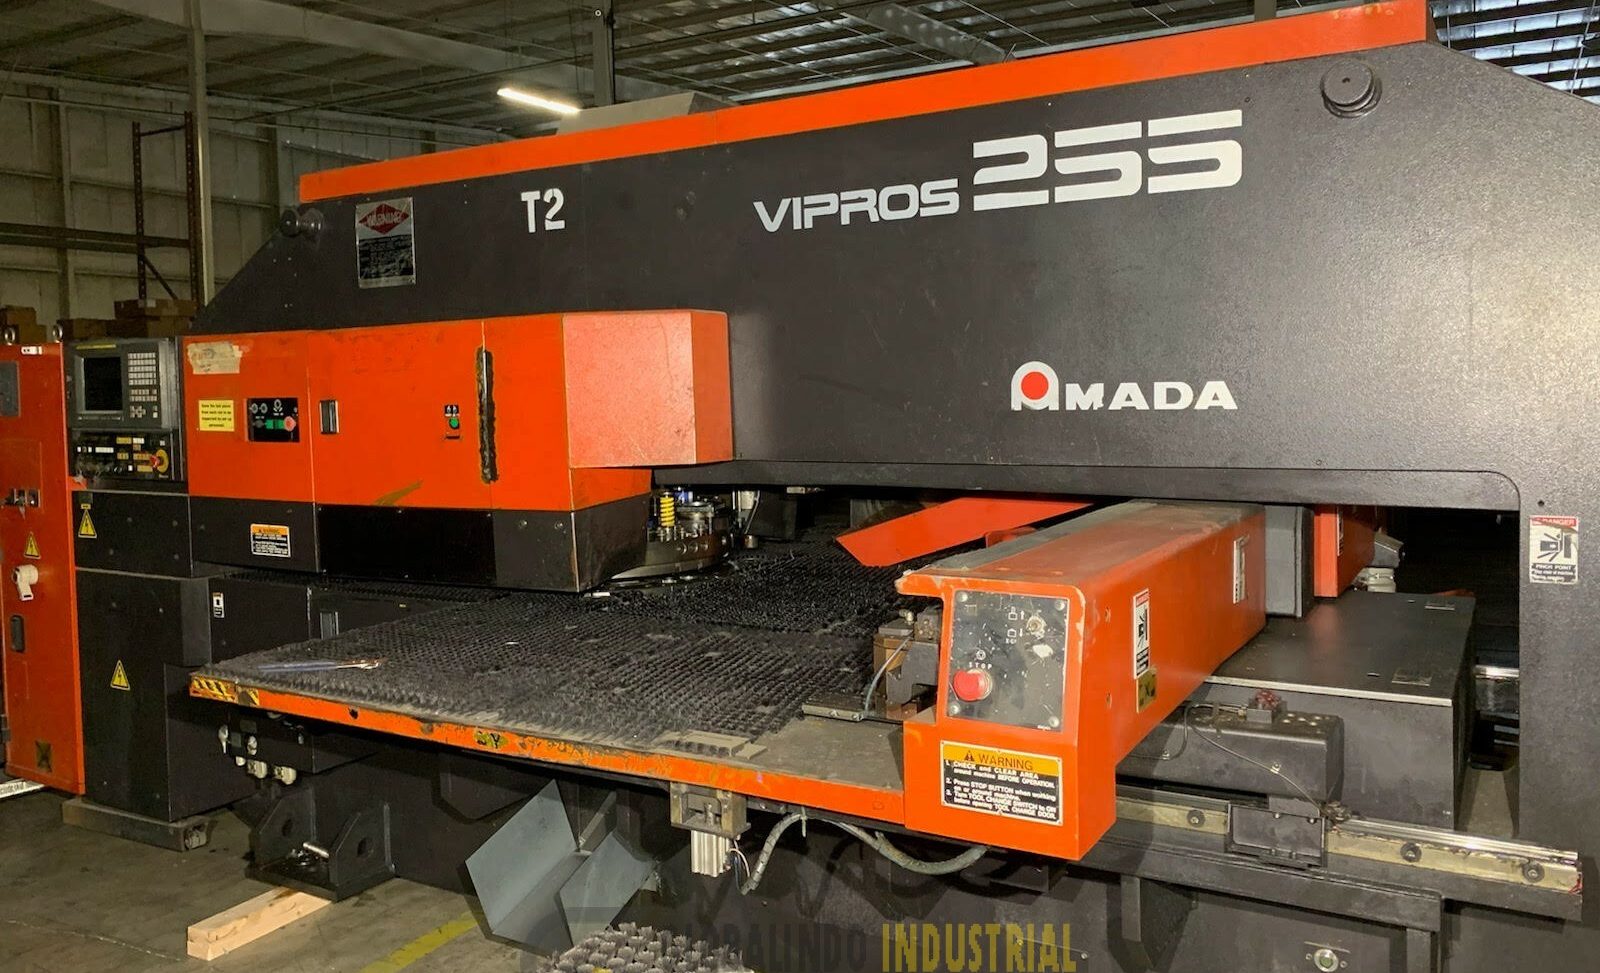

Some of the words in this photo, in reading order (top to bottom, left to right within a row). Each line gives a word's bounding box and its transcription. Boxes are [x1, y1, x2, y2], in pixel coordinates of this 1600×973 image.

[753, 178, 959, 232] VIPROS
[973, 109, 1242, 212] 255
[520, 188, 565, 233] T2
[1011, 361, 1238, 411] AMADA
[953, 761, 976, 770] CHECK
[994, 767, 1017, 776] CLEAR
[978, 753, 1033, 770] WARNING
[971, 780, 987, 789] STOP
[988, 782, 1014, 794] BUTTON
